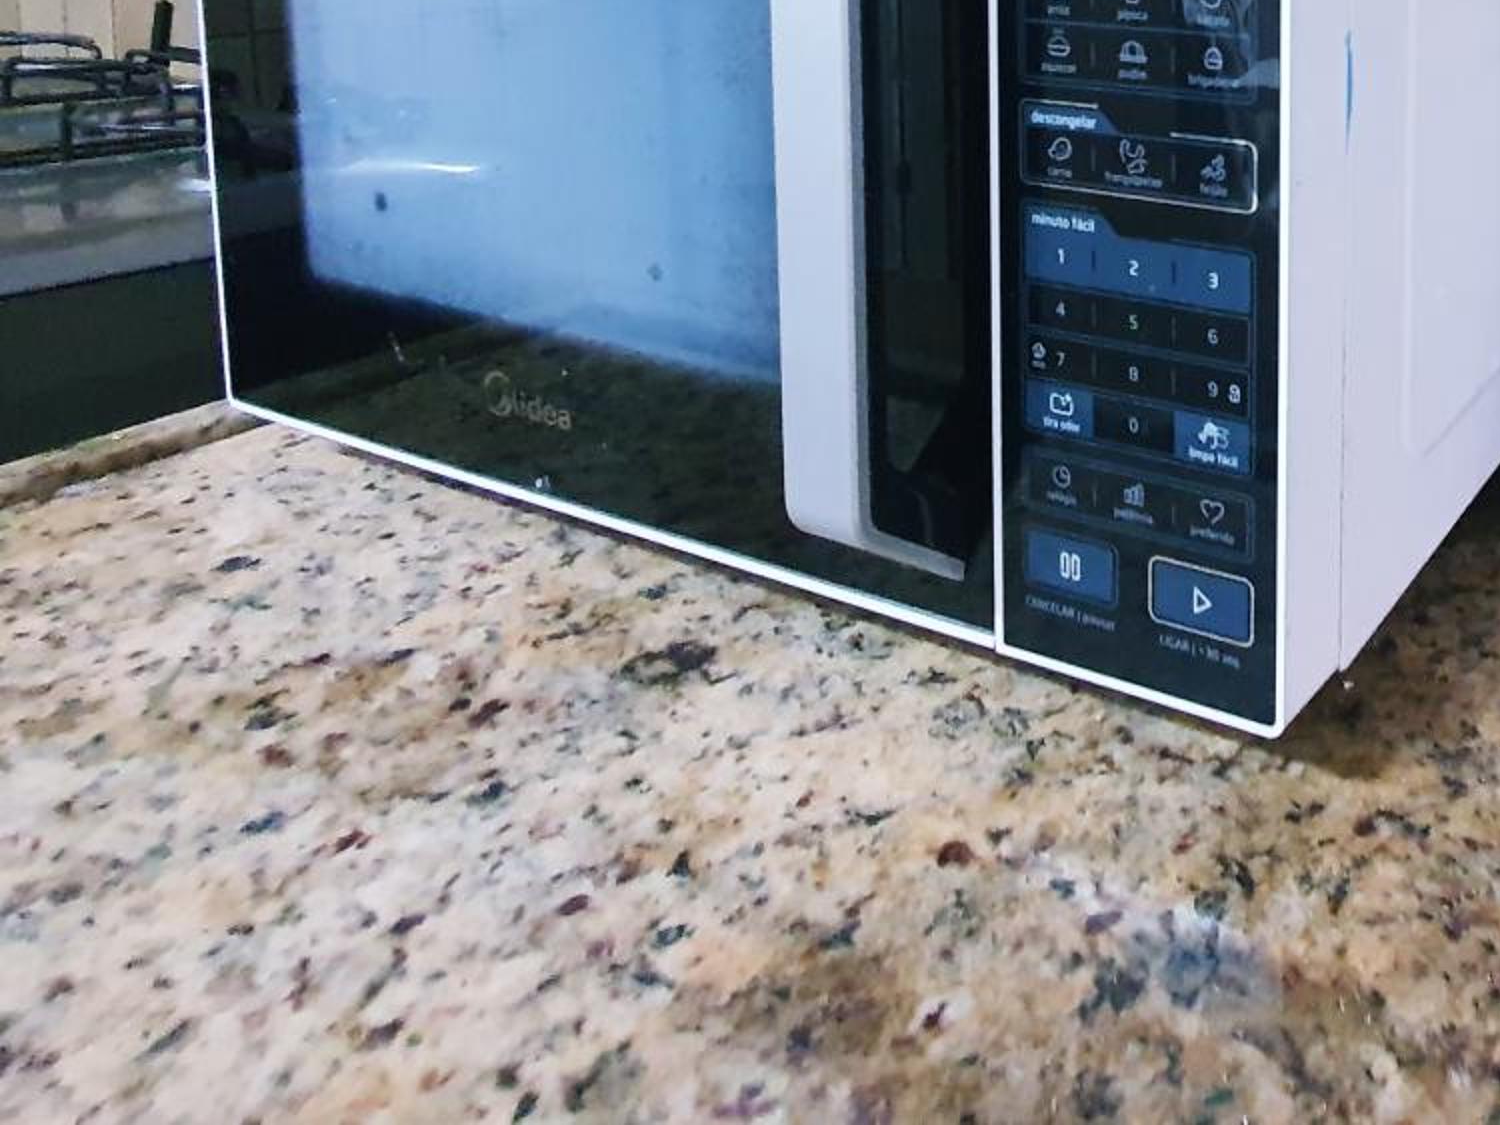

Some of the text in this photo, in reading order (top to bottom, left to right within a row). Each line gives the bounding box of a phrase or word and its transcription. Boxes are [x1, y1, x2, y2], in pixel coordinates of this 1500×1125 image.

[1031, 212, 1070, 229] minuto
[1057, 248, 1066, 265] 1
[1129, 260, 1139, 277] 2
[1208, 272, 1219, 290] 3
[1056, 300, 1065, 317] 4
[1128, 314, 1138, 330] 5
[1207, 328, 1218, 345] 6
[1057, 351, 1066, 367] 7
[1128, 365, 1139, 383] 8
[1207, 381, 1219, 398] 9
[1128, 417, 1139, 434] 0
